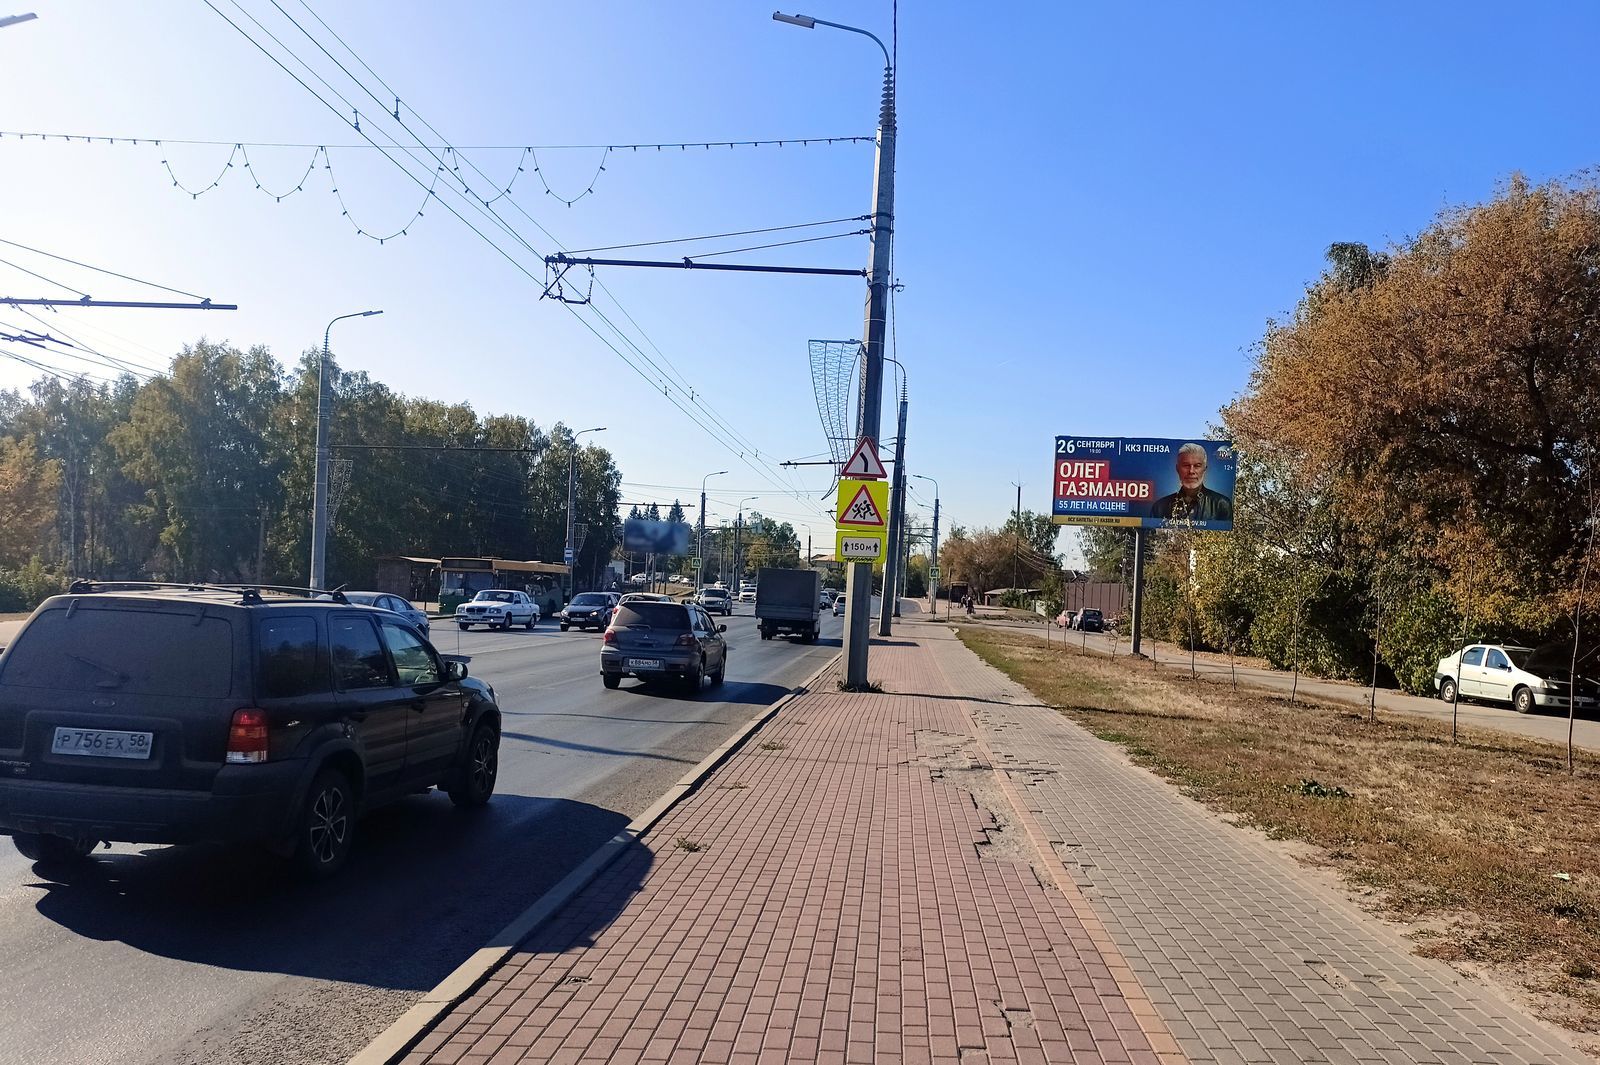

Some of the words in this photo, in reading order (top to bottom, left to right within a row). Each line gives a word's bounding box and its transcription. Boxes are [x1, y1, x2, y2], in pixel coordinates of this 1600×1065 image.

[1057, 439, 1075, 454] 26
[1076, 440, 1115, 449] СЕНТЯБРЯ
[1125, 444, 1141, 452] ККЗ
[1143, 444, 1170, 453] ПЕНЗА
[1059, 462, 1105, 479] ОЛЕГ
[1058, 481, 1150, 498] ГАЗМАНОВ
[1059, 501, 1069, 509] 55
[1070, 501, 1086, 510] ЛЕТ
[1087, 502, 1098, 510] НА
[1100, 502, 1126, 511] СЦЕНЕ
[850, 543, 865, 551] 150
